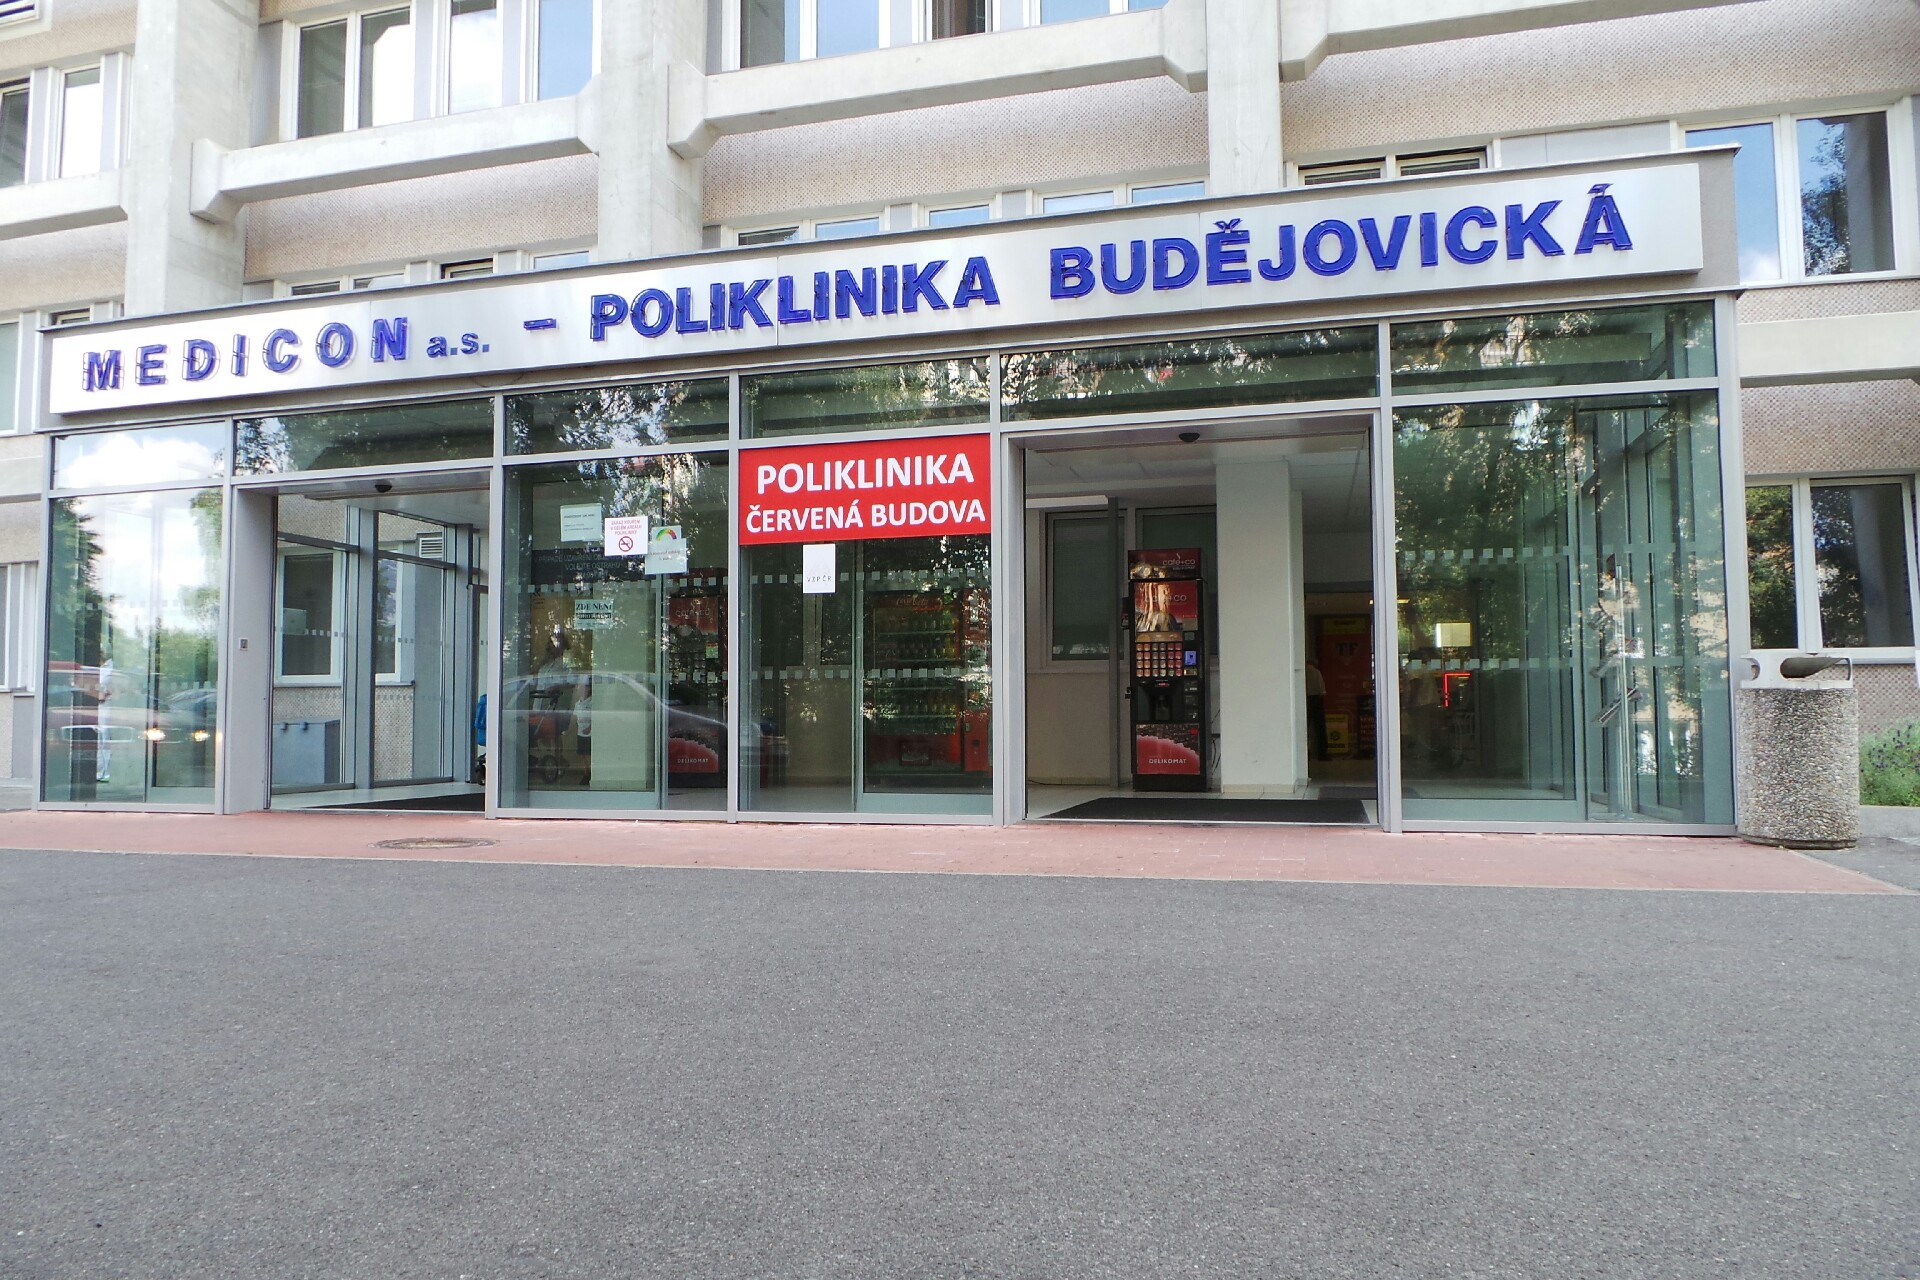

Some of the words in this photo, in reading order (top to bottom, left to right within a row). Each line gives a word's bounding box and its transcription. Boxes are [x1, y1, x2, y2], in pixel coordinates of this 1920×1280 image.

[82, 316, 409, 393] MEDICON
[426, 331, 490, 359] a.s.
[590, 255, 1001, 343] POLIKLINIKA
[1049, 182, 1634, 300] BUDĚJOVICKÁ
[756, 452, 975, 495] POLIKLINIKA
[745, 499, 864, 534] ČERVENÁ
[870, 498, 987, 528] BUDOVA
